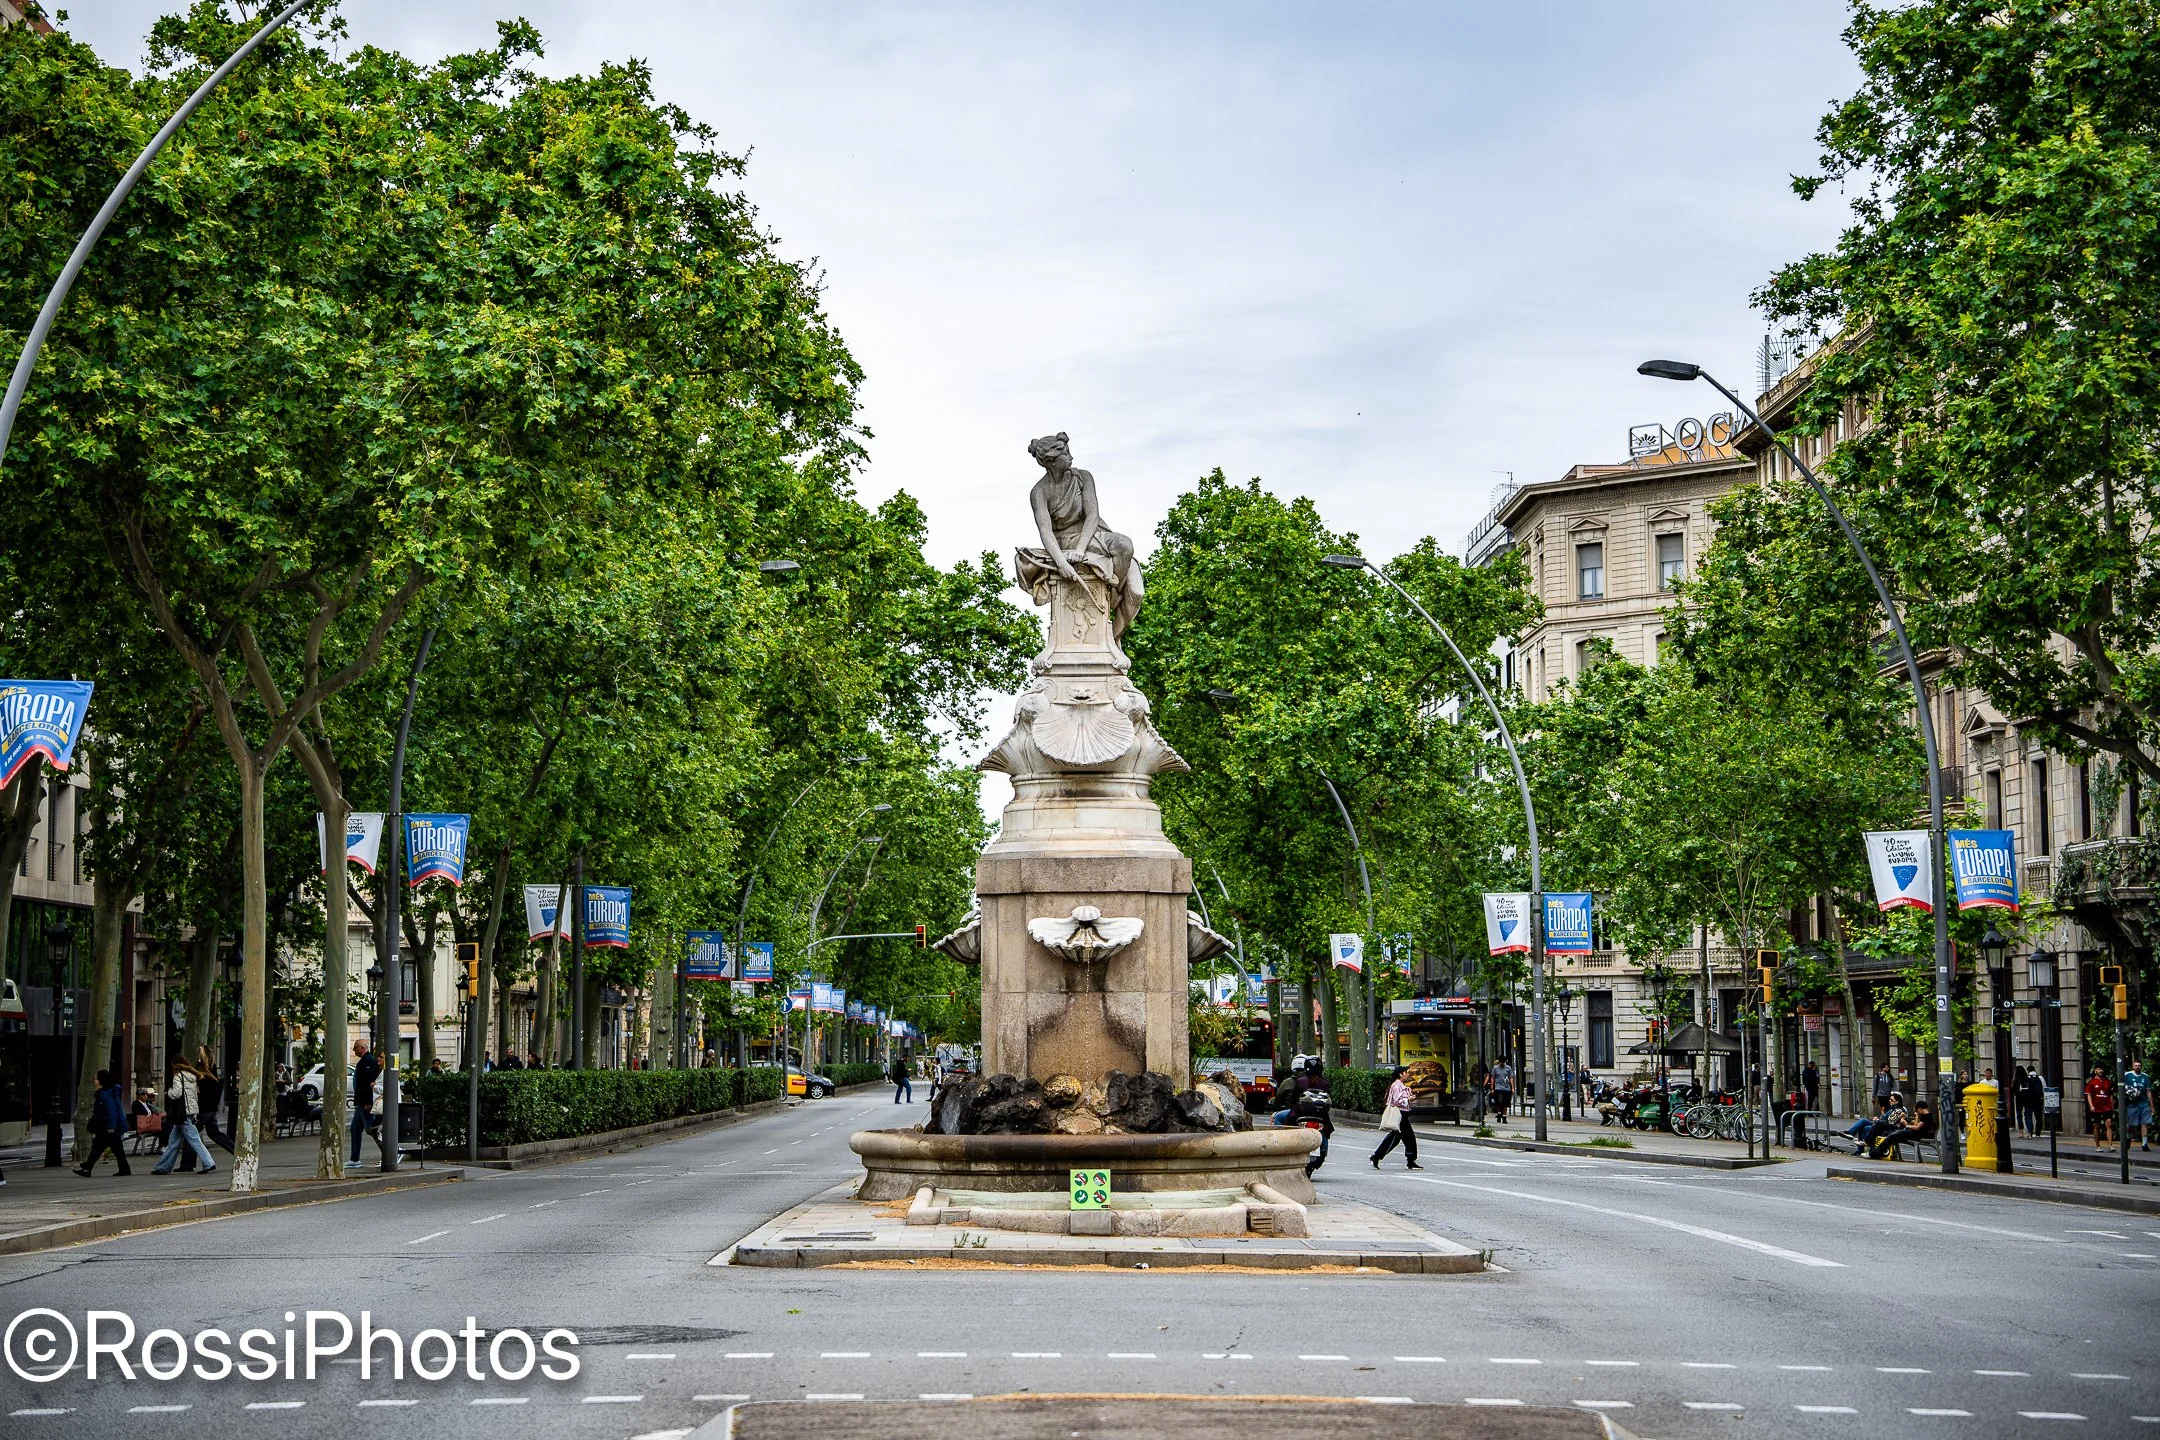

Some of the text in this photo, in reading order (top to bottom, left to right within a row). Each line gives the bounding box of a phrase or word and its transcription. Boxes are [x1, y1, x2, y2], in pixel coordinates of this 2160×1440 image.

[8, 722, 60, 745] BARCELONA
[411, 827, 461, 857] EUROPA
[418, 850, 456, 861] BARCELONA
[1956, 848, 2013, 879] EUROPA
[1967, 877, 2008, 885] BARCELONA
[589, 900, 626, 924] EUROPA
[1548, 908, 1588, 931] EUROPA
